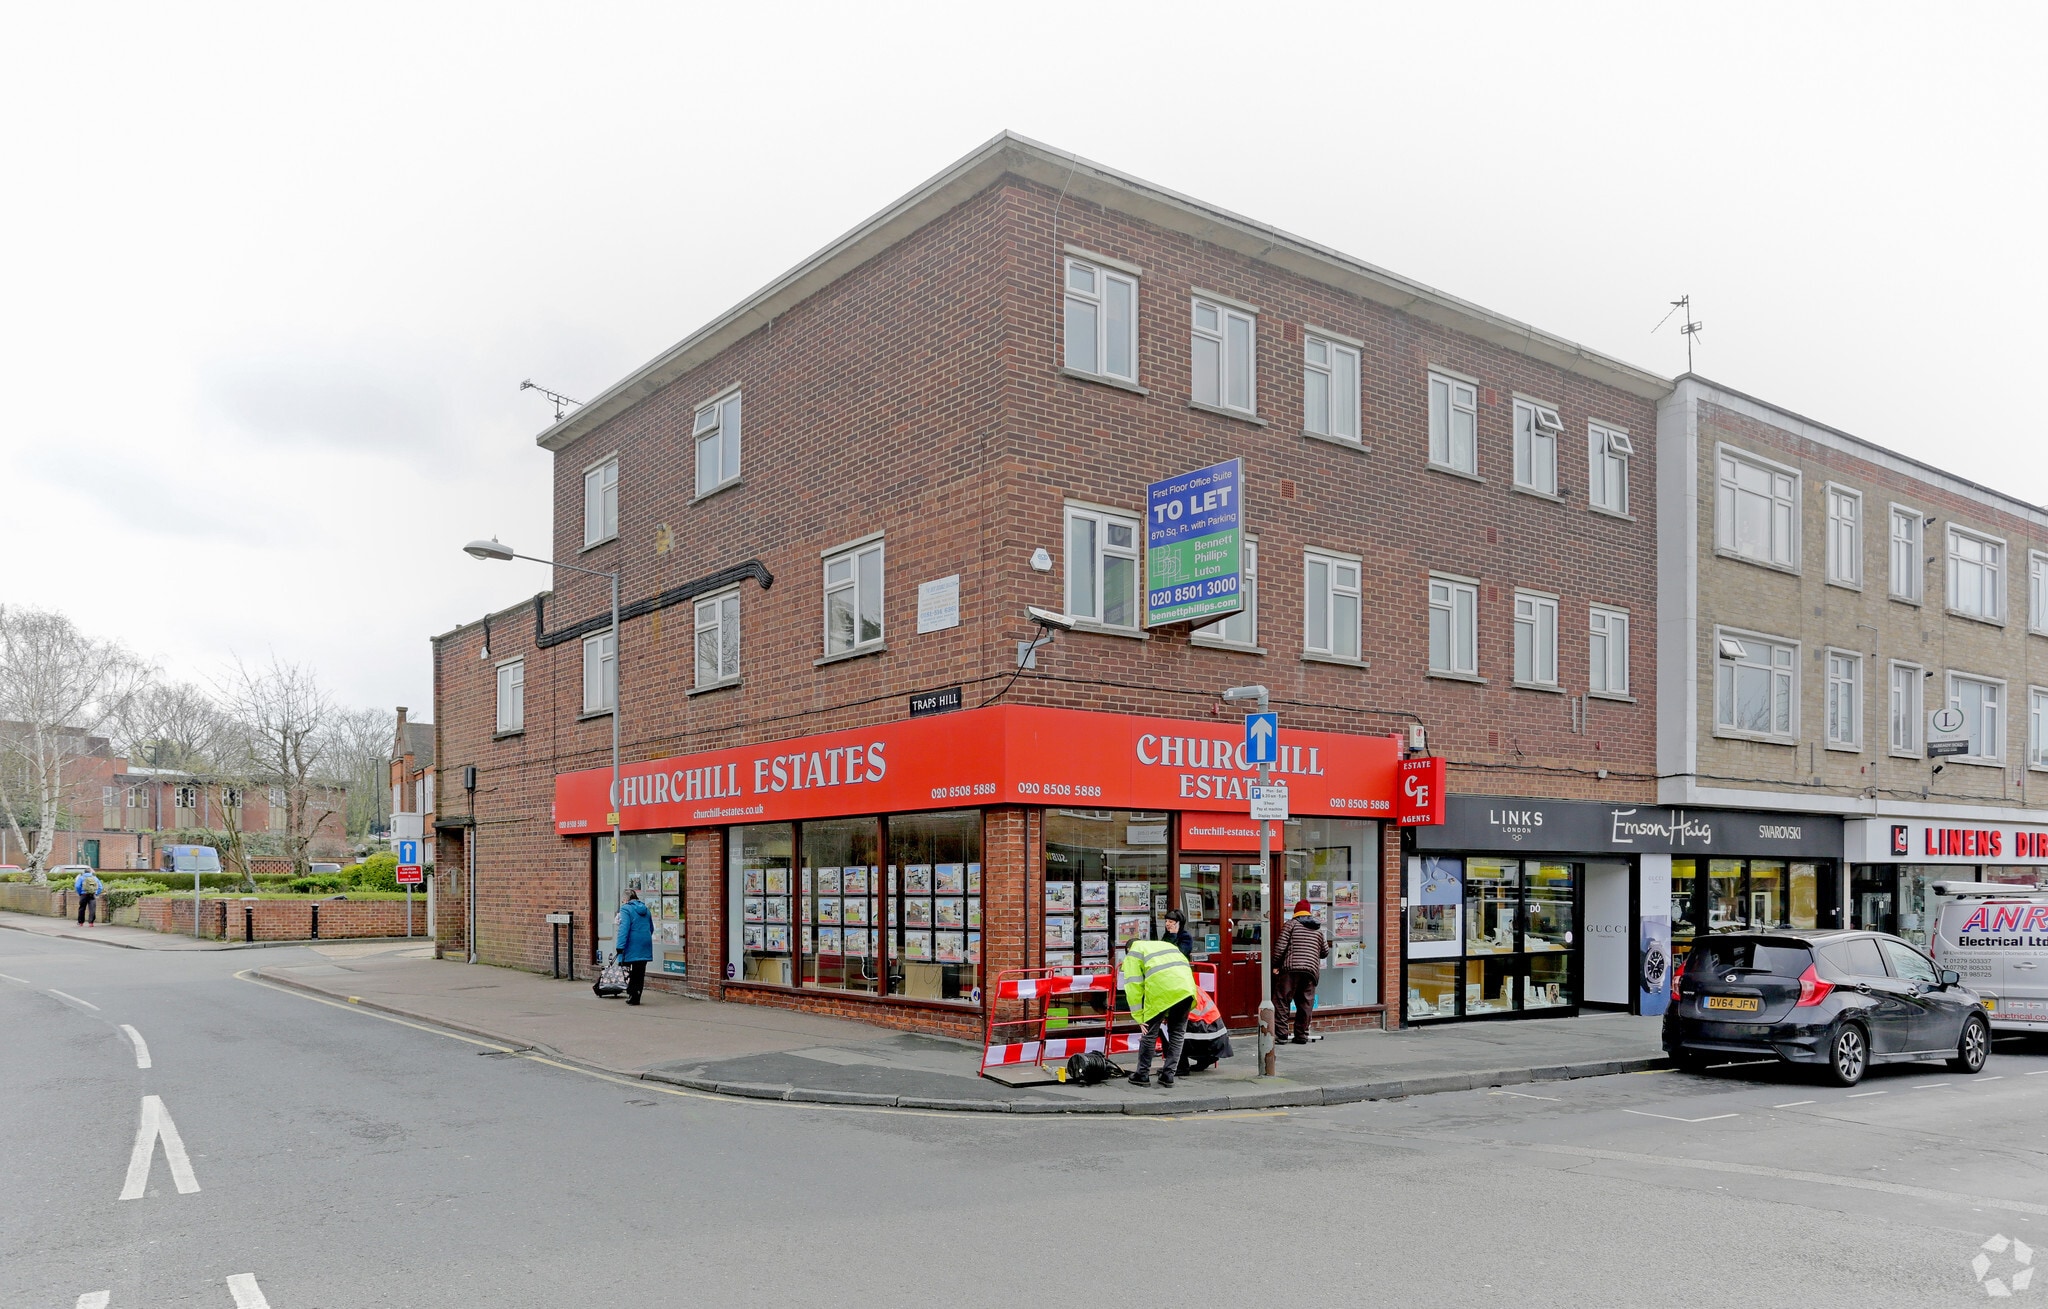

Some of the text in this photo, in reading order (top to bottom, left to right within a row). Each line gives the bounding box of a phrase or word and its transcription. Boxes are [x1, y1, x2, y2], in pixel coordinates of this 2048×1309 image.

[1152, 471, 1232, 499] First Floor Office Suite
[1154, 486, 1232, 523] TO LET
[1151, 512, 1236, 540] 870 Sq. Ft. with Parking
[1194, 535, 1232, 551] Bennett
[1194, 550, 1228, 564] Phillips
[1194, 565, 1221, 577] Luton
[1151, 577, 1236, 606] 020 8501 3000
[1151, 599, 1237, 621] bennettphillips.com
[912, 694, 959, 711] TRAPS HILL
[1943, 712, 1956, 727] L
[1136, 733, 1324, 776] CHURCILL
[1403, 761, 1431, 770] ESTATE
[609, 742, 887, 808] CHURCHILL ESTATES
[930, 783, 996, 799] 020 8508 5888
[1017, 782, 1102, 797] 020 8508 5888
[1179, 774, 1287, 800] ESTAT
[693, 803, 764, 819] churchill-estates.co.uk
[1329, 798, 1390, 810] 020 8508 5888
[1401, 814, 1431, 823] AGENTS
[1490, 809, 1543, 826] LINKS
[1189, 827, 1277, 837] churchill-estates.cuk
[1611, 809, 1712, 845] Emson Haig
[1759, 825, 1801, 840] SWAROVSKI
[1925, 827, 2002, 858] LINENS
[1961, 906, 2048, 932] ANR
[1586, 924, 1627, 933] GUCCI
[1959, 936, 2048, 947] Electrical Ltd
[1709, 998, 1756, 1009] DV64 JFN
